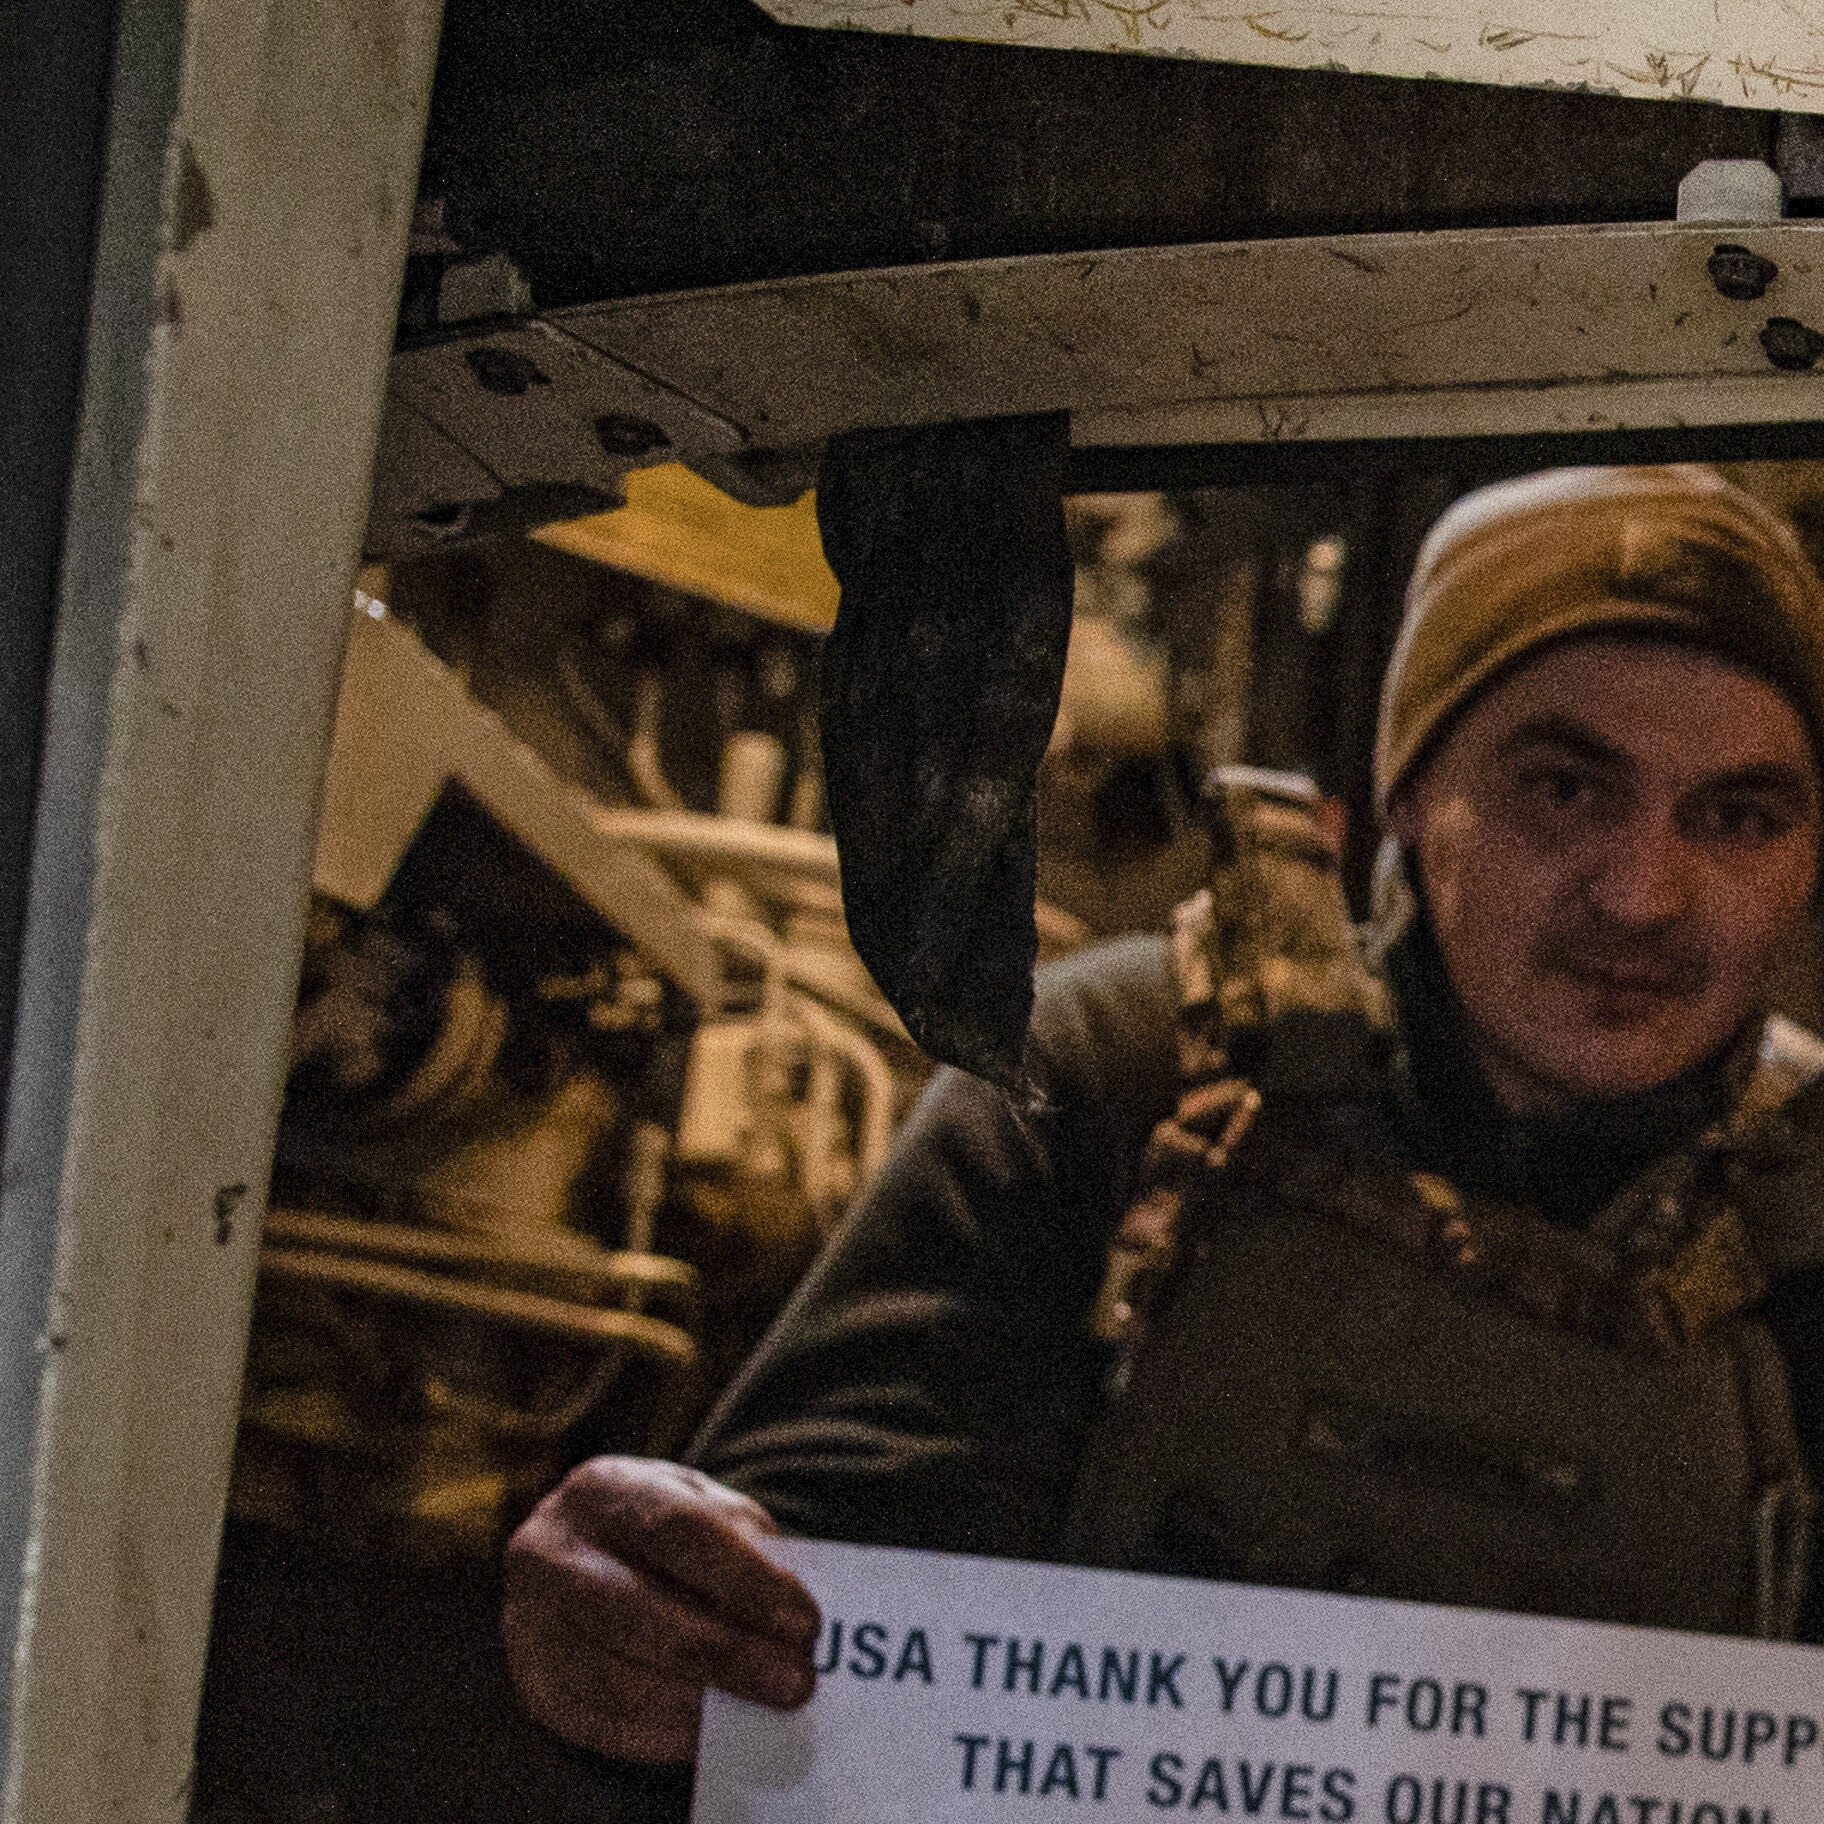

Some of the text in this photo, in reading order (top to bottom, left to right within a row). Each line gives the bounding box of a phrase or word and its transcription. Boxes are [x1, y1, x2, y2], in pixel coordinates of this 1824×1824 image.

[814, 1618, 935, 1686] USA
[964, 1632, 1187, 1710] THANK
[1212, 1657, 1340, 1725] YOU
[1365, 1672, 1490, 1739] FOR
[1516, 1687, 1632, 1753] THE
[953, 1732, 1122, 1803] THAT
[1145, 1751, 1357, 1824] SAVES
